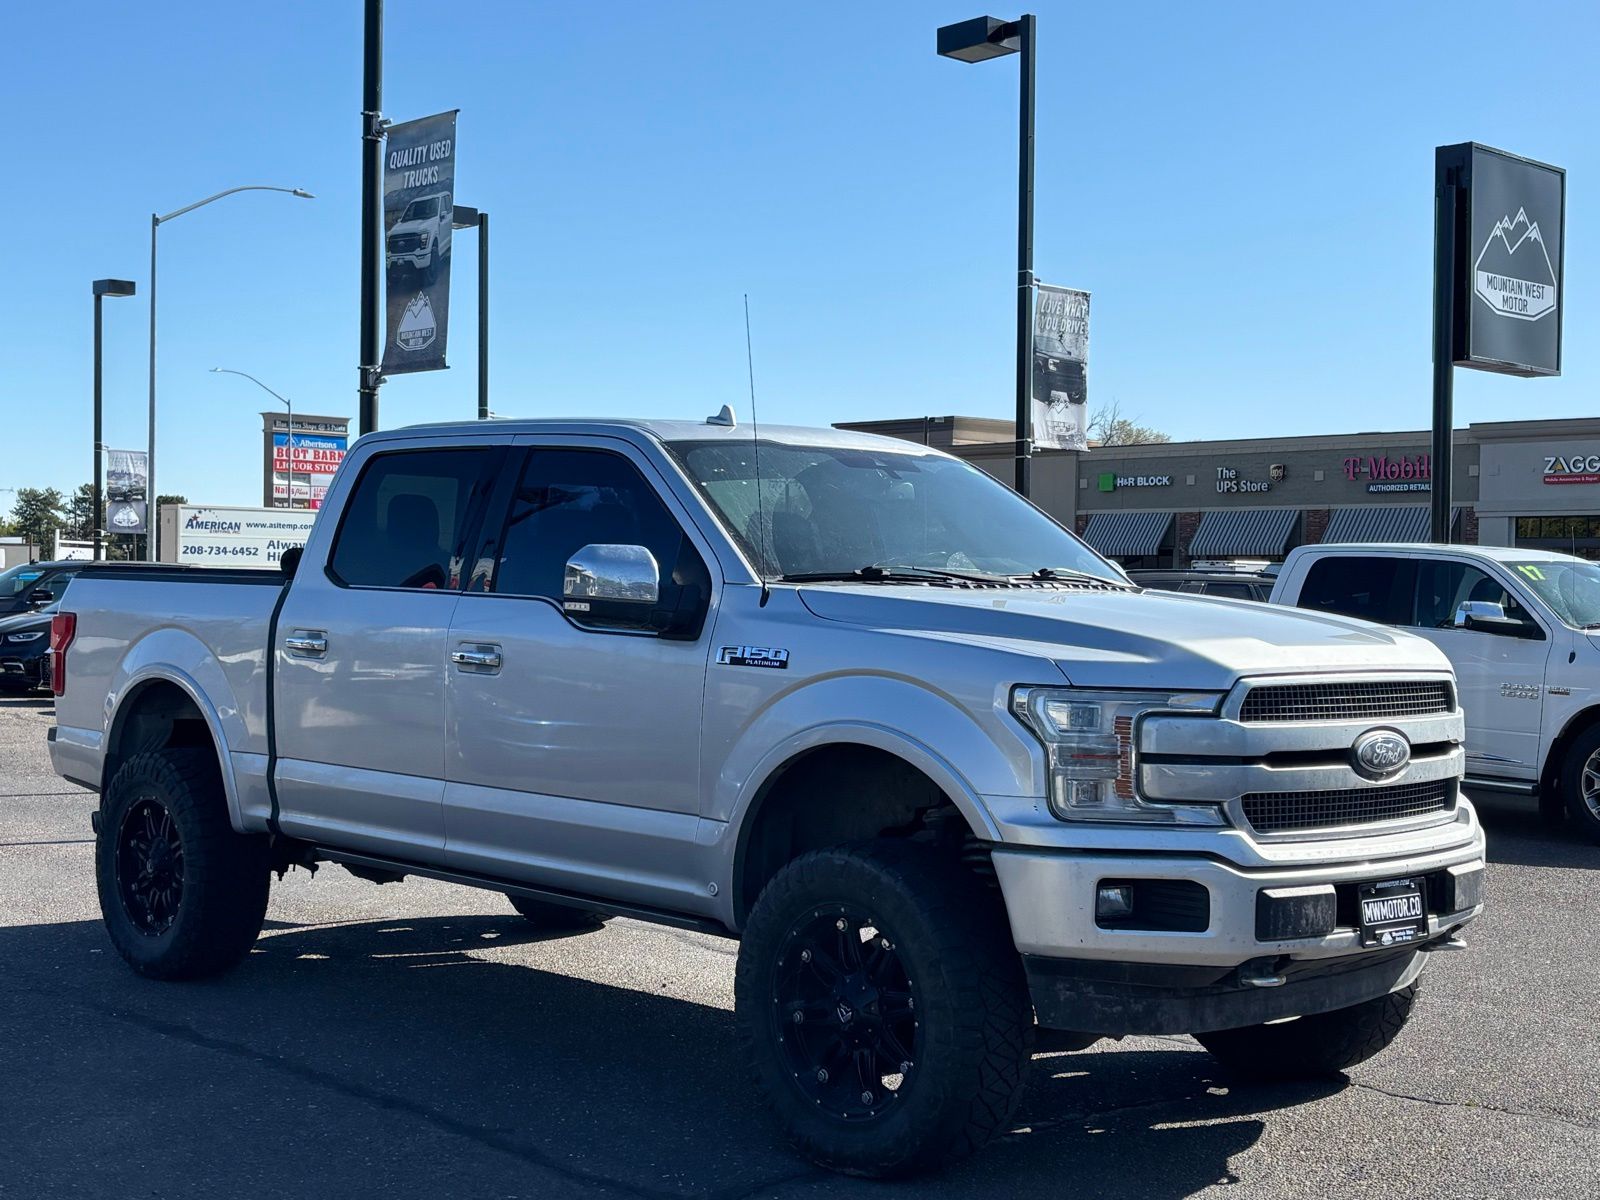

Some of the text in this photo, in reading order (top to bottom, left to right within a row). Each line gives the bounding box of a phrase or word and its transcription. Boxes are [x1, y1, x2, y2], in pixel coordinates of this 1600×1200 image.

[389, 139, 451, 170] QUALITY USED
[403, 165, 439, 189] TRUCKS
[1486, 274, 1545, 300] MOUNTAIN WEST
[1041, 298, 1087, 318] LOVE WHAT
[1502, 294, 1528, 312] MOTOR
[1040, 315, 1086, 334] YOU DRIVE
[299, 439, 337, 449] Albertsons
[276, 447, 345, 461] BOOT BARN
[276, 461, 338, 472] LIQUOR STOR
[1344, 453, 1431, 480] T-Mobil
[1543, 455, 1600, 474] ZAGG
[1216, 467, 1236, 480] The
[1116, 475, 1170, 487] H&R BLOCK
[1216, 479, 1268, 493] UPS Store
[1368, 483, 1431, 492] AUTHORIZED RETAIL
[274, 486, 294, 495] Nais
[185, 518, 241, 531] AMERICAN
[182, 545, 259, 557] 208-734-6452
[266, 540, 306, 550] Alwa
[1517, 565, 1546, 581] 17
[745, 659, 780, 667] PLATINUM
[1372, 742, 1403, 765] Ford
[1364, 896, 1421, 922] MWMOTOR.CO
